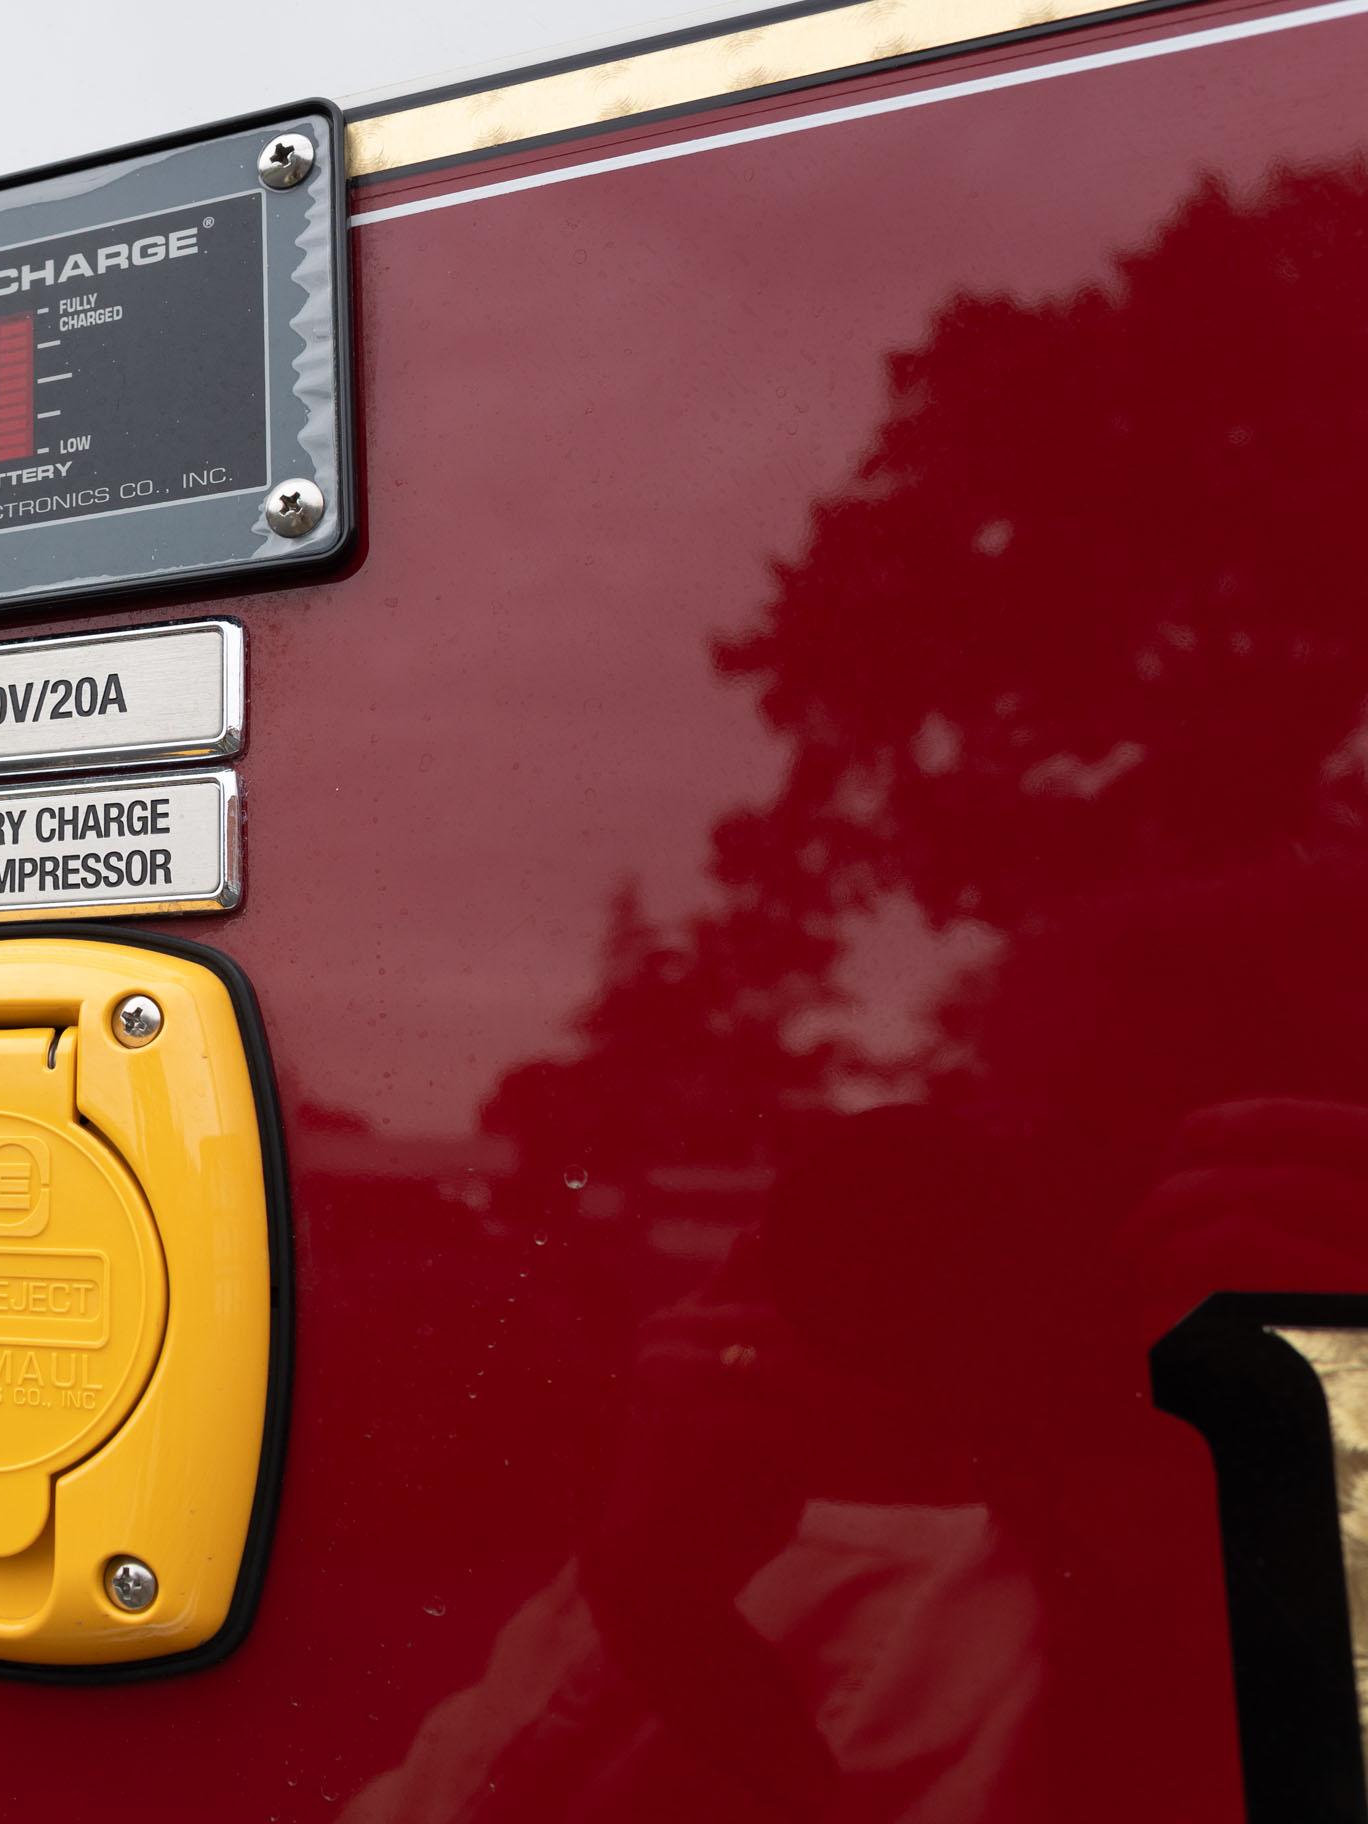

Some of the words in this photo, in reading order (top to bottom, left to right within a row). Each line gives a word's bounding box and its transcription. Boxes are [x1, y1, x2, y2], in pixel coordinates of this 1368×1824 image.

[59, 294, 97, 314] FULLY
[59, 306, 123, 331] CHARGED
[60, 435, 92, 455] LOW
[182, 467, 234, 489] INC.
[35, 798, 171, 843] CHARGE
